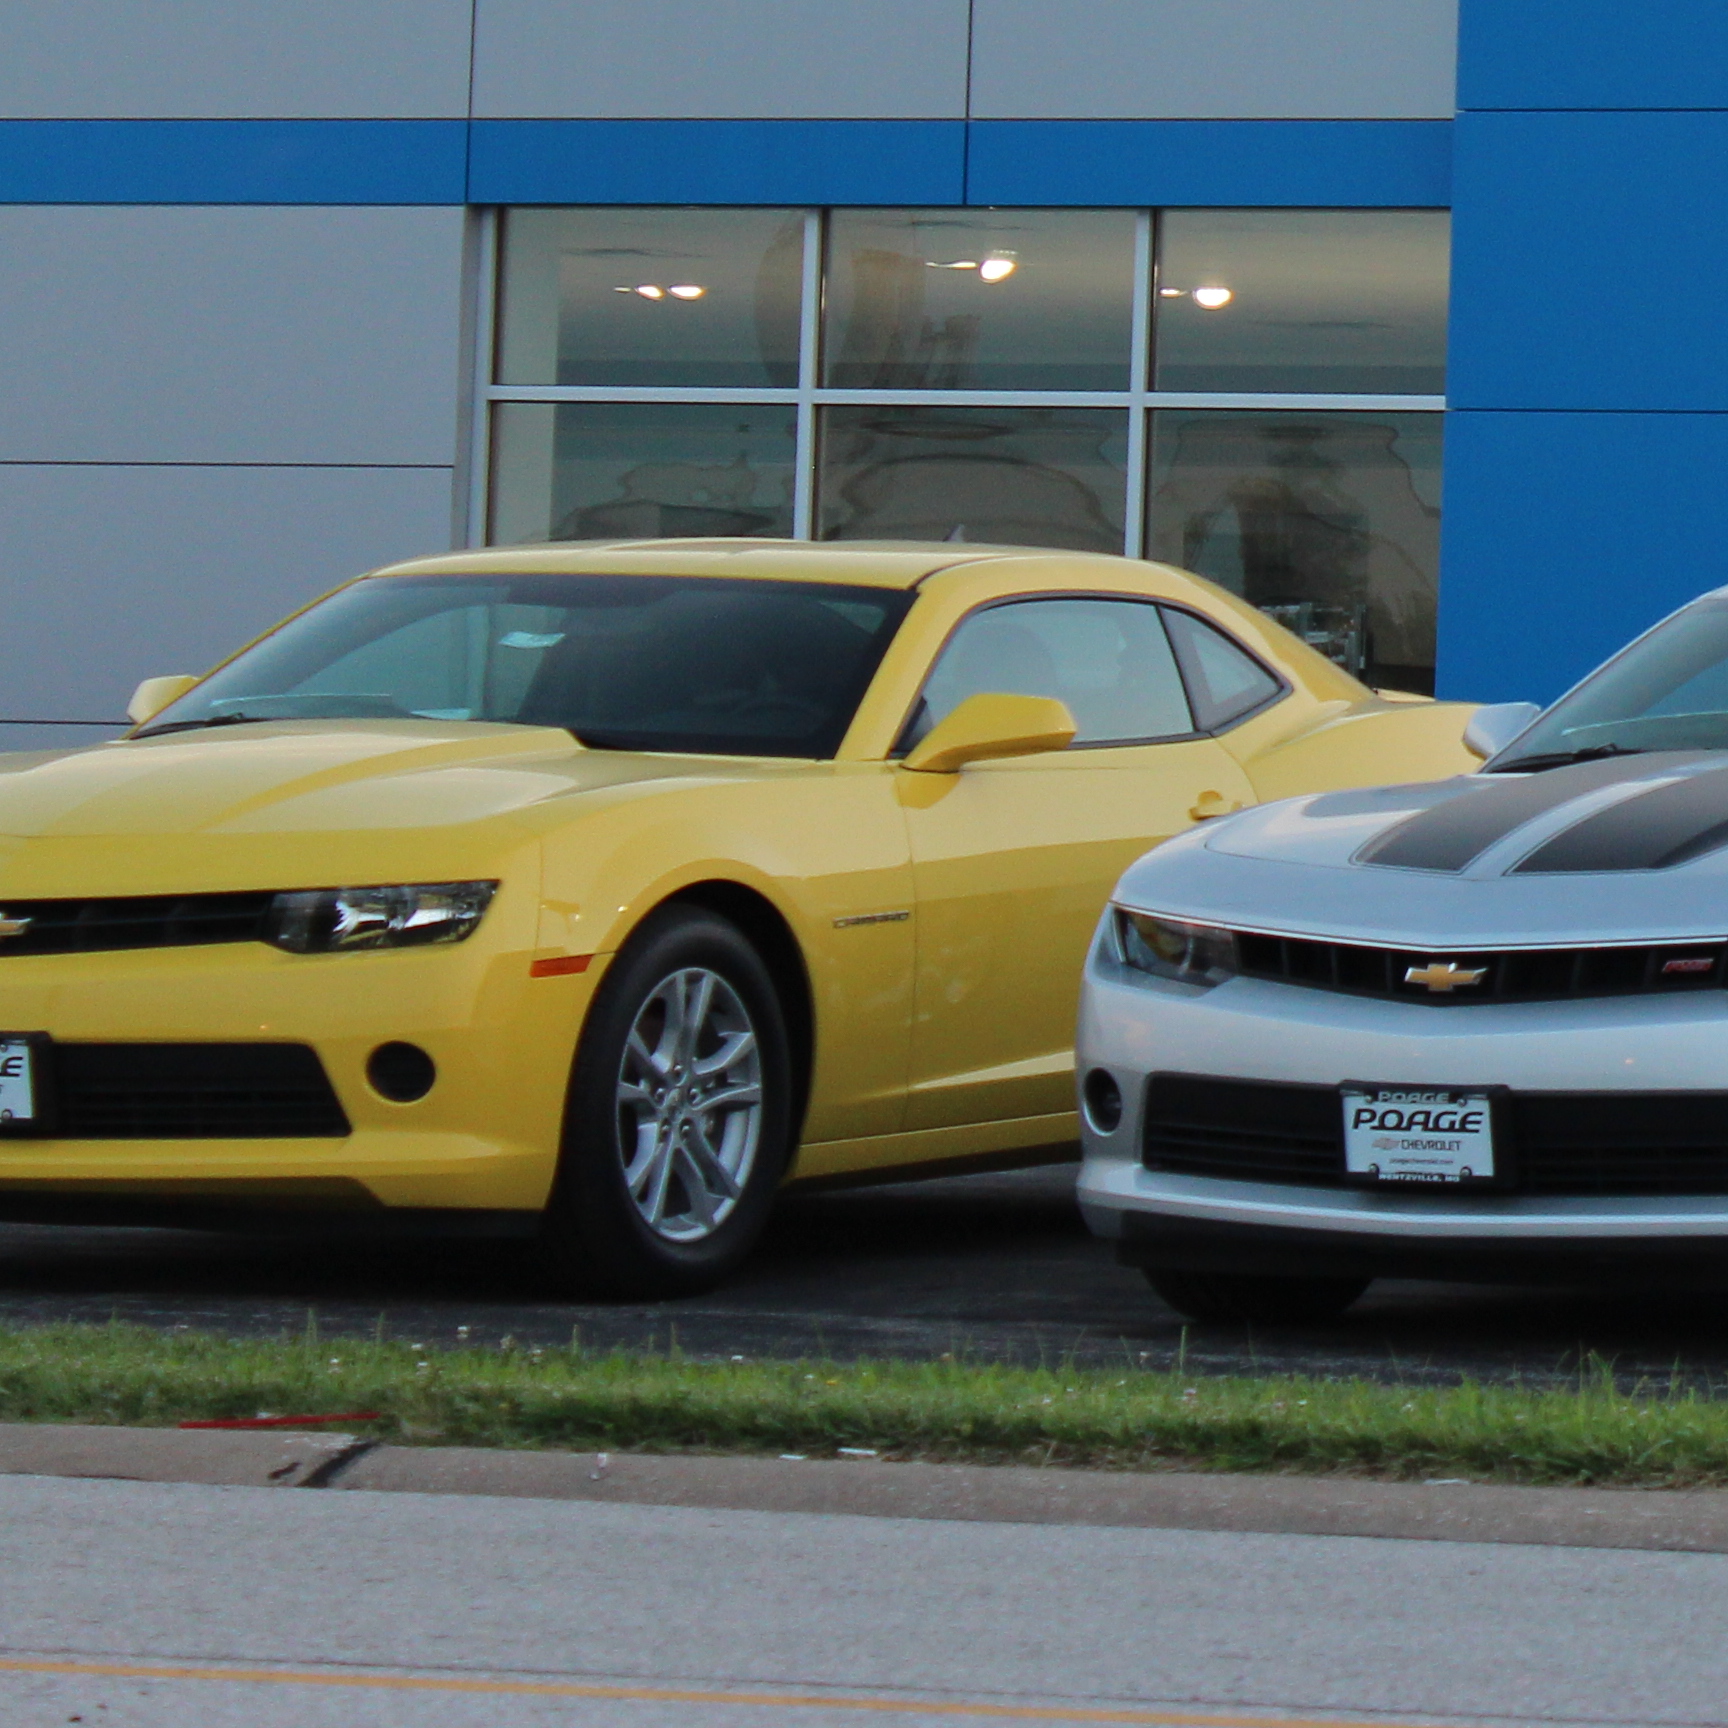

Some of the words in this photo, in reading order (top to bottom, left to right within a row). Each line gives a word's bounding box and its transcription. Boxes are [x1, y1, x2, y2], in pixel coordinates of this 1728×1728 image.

[1378, 1091, 1451, 1104] POAGE
[1352, 1108, 1484, 1133] POAGE
[1401, 1139, 1461, 1151] CHEVROLET
